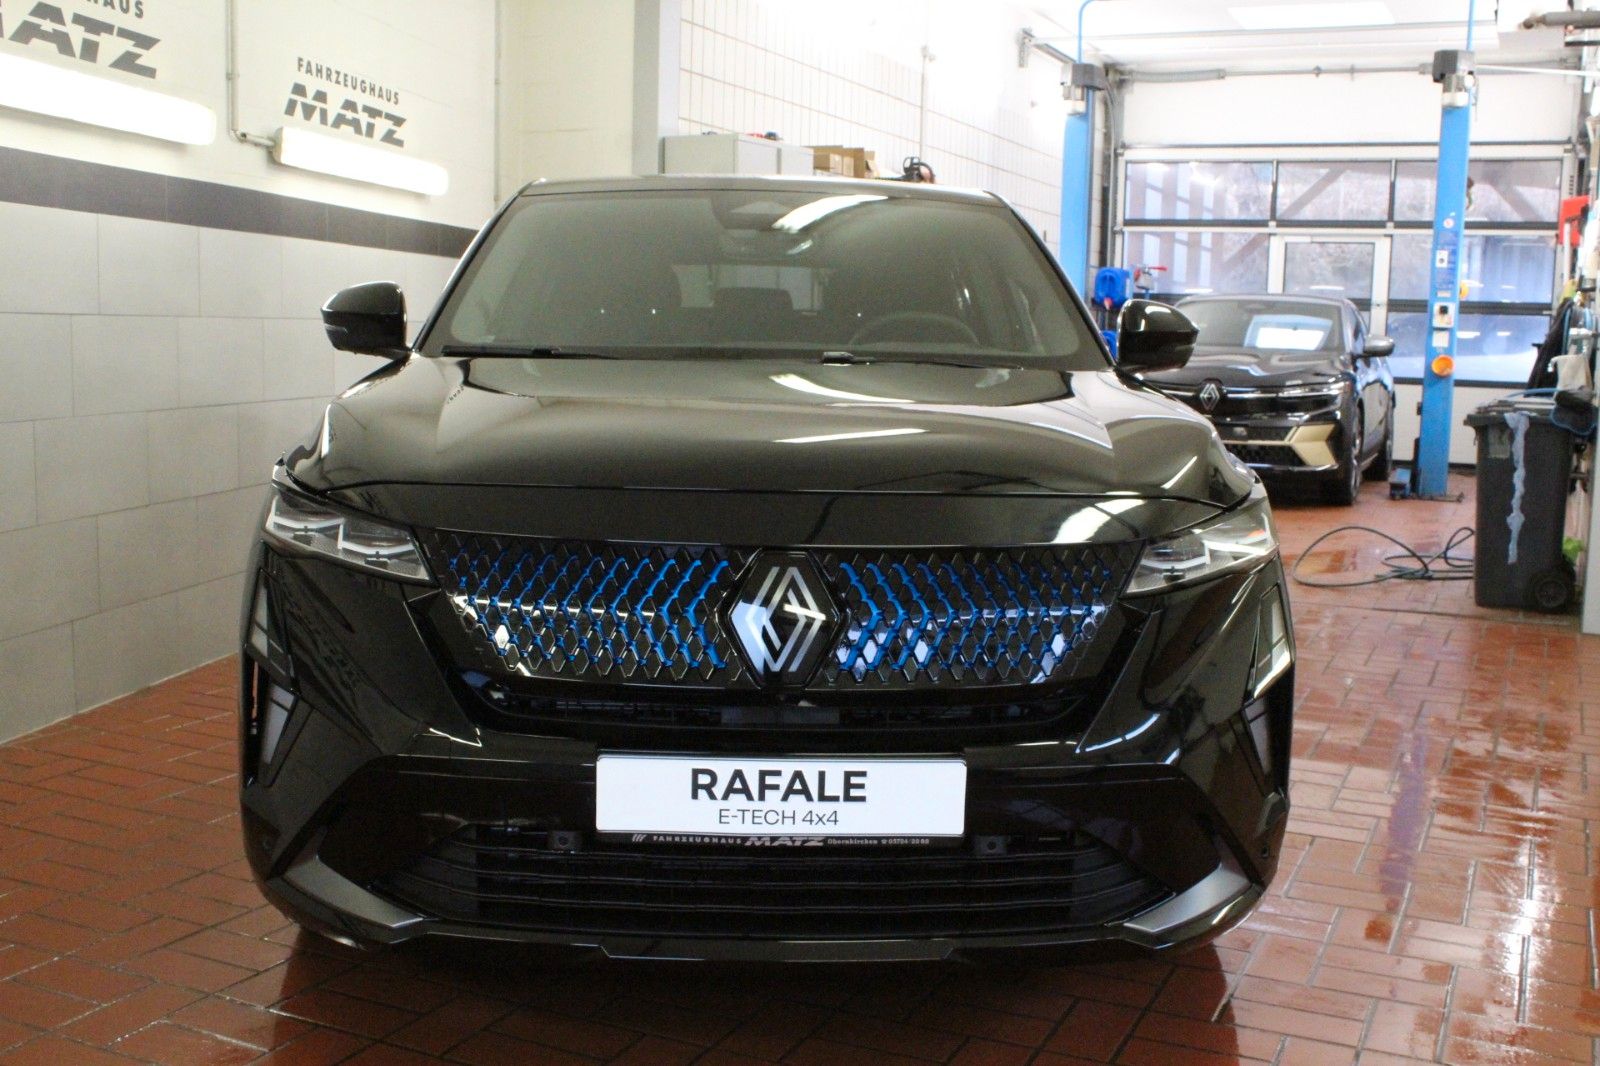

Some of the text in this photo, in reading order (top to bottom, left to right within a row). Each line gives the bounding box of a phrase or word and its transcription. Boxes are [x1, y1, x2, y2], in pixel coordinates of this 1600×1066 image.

[0, 1, 161, 79] ATZ
[297, 56, 400, 106] FAHRZEUGHAUS
[284, 81, 407, 148] MATZ
[691, 768, 868, 803] RAFALE
[718, 808, 840, 826] E-TECH 4x4
[652, 834, 742, 844] FAHRZEUGHAUS
[744, 836, 825, 847] MATZ
